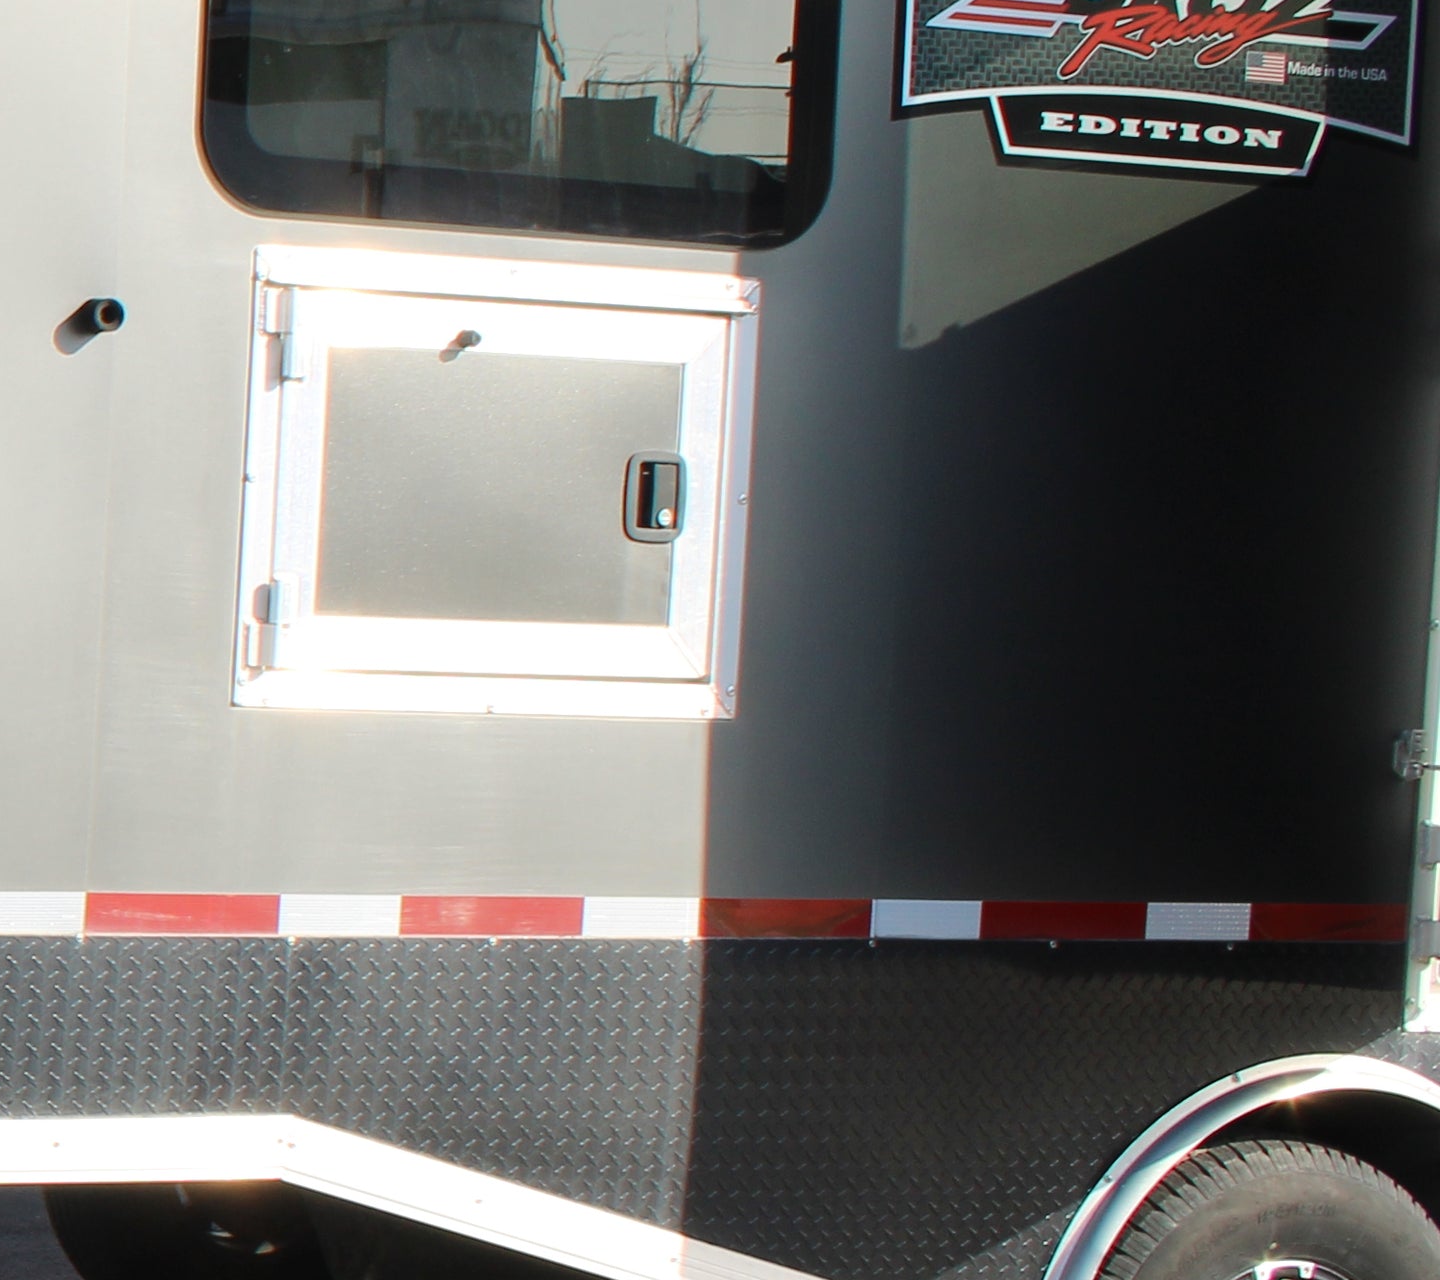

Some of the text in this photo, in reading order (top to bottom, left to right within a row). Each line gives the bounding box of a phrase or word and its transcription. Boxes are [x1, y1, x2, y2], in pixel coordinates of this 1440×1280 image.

[1057, 3, 1333, 78] Racing
[1287, 61, 1388, 82] Made in the USA
[1040, 111, 1282, 148] EDITION
